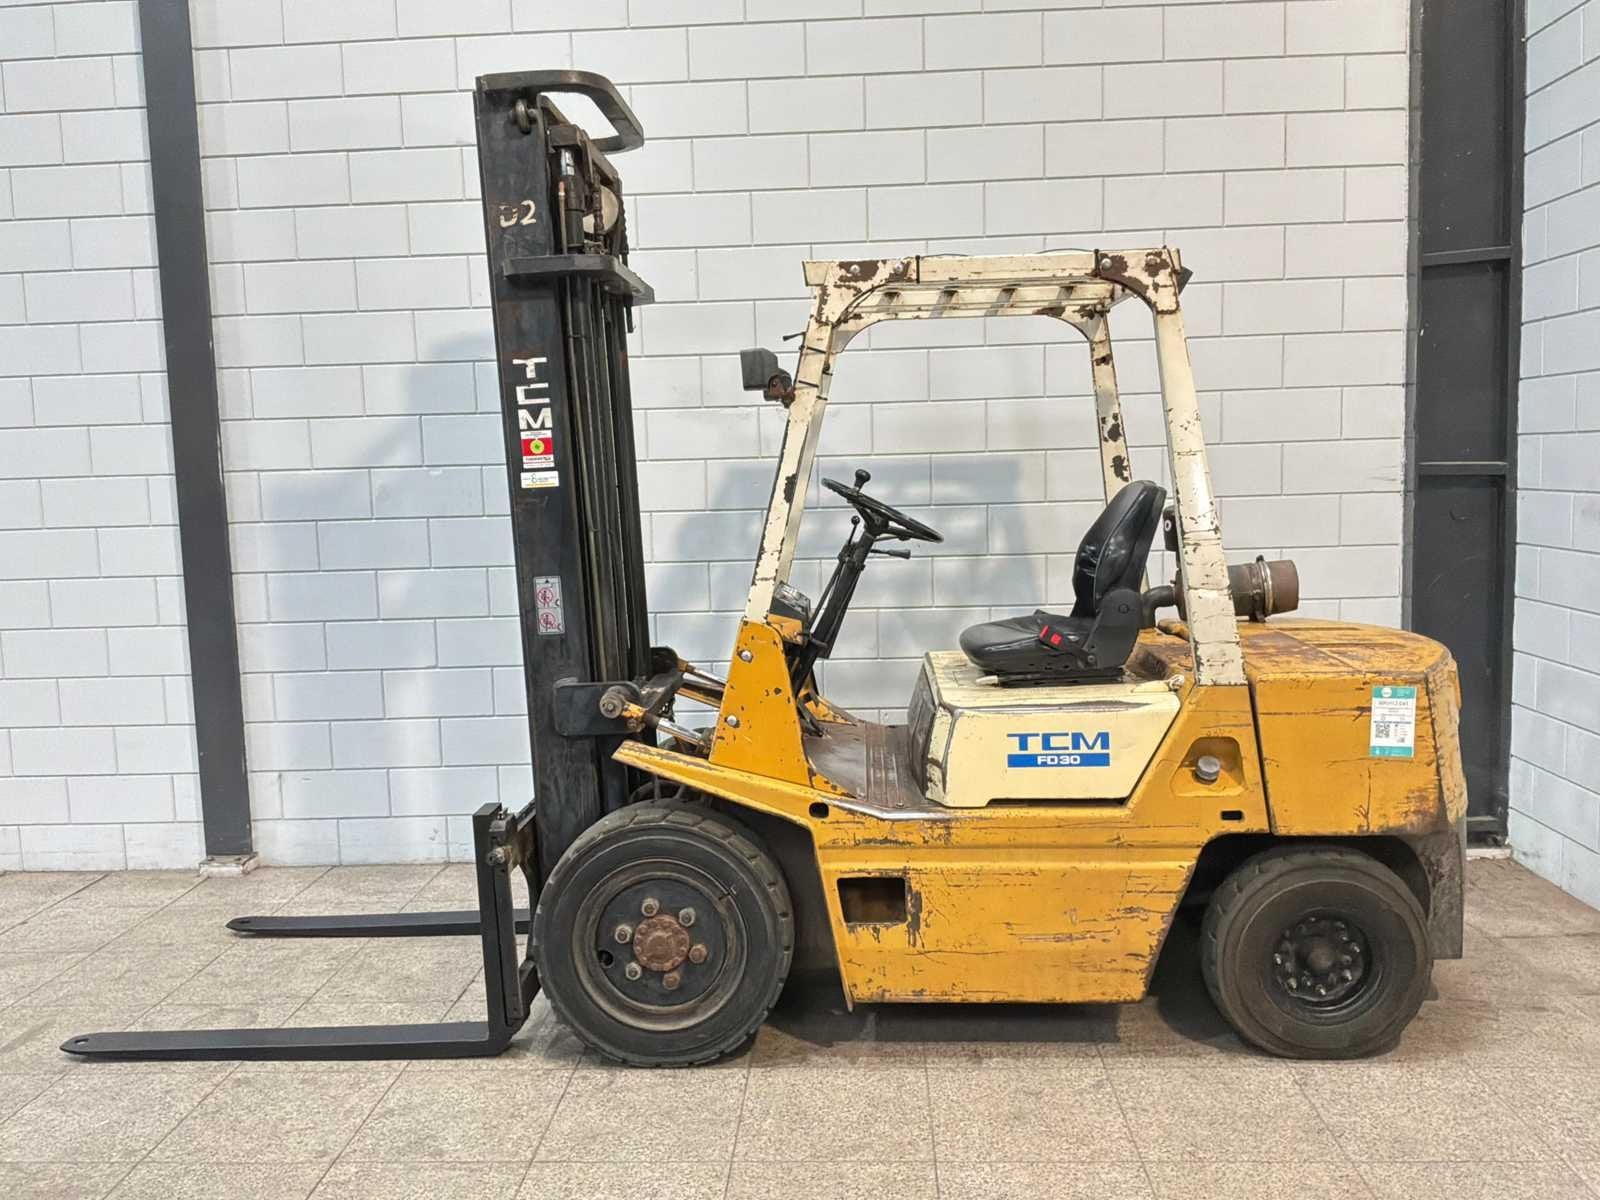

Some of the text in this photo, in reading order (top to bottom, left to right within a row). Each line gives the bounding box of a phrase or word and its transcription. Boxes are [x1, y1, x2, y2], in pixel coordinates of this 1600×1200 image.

[512, 357, 553, 430] TCM
[1006, 732, 1110, 751] TCM
[1036, 754, 1081, 766] FD30
